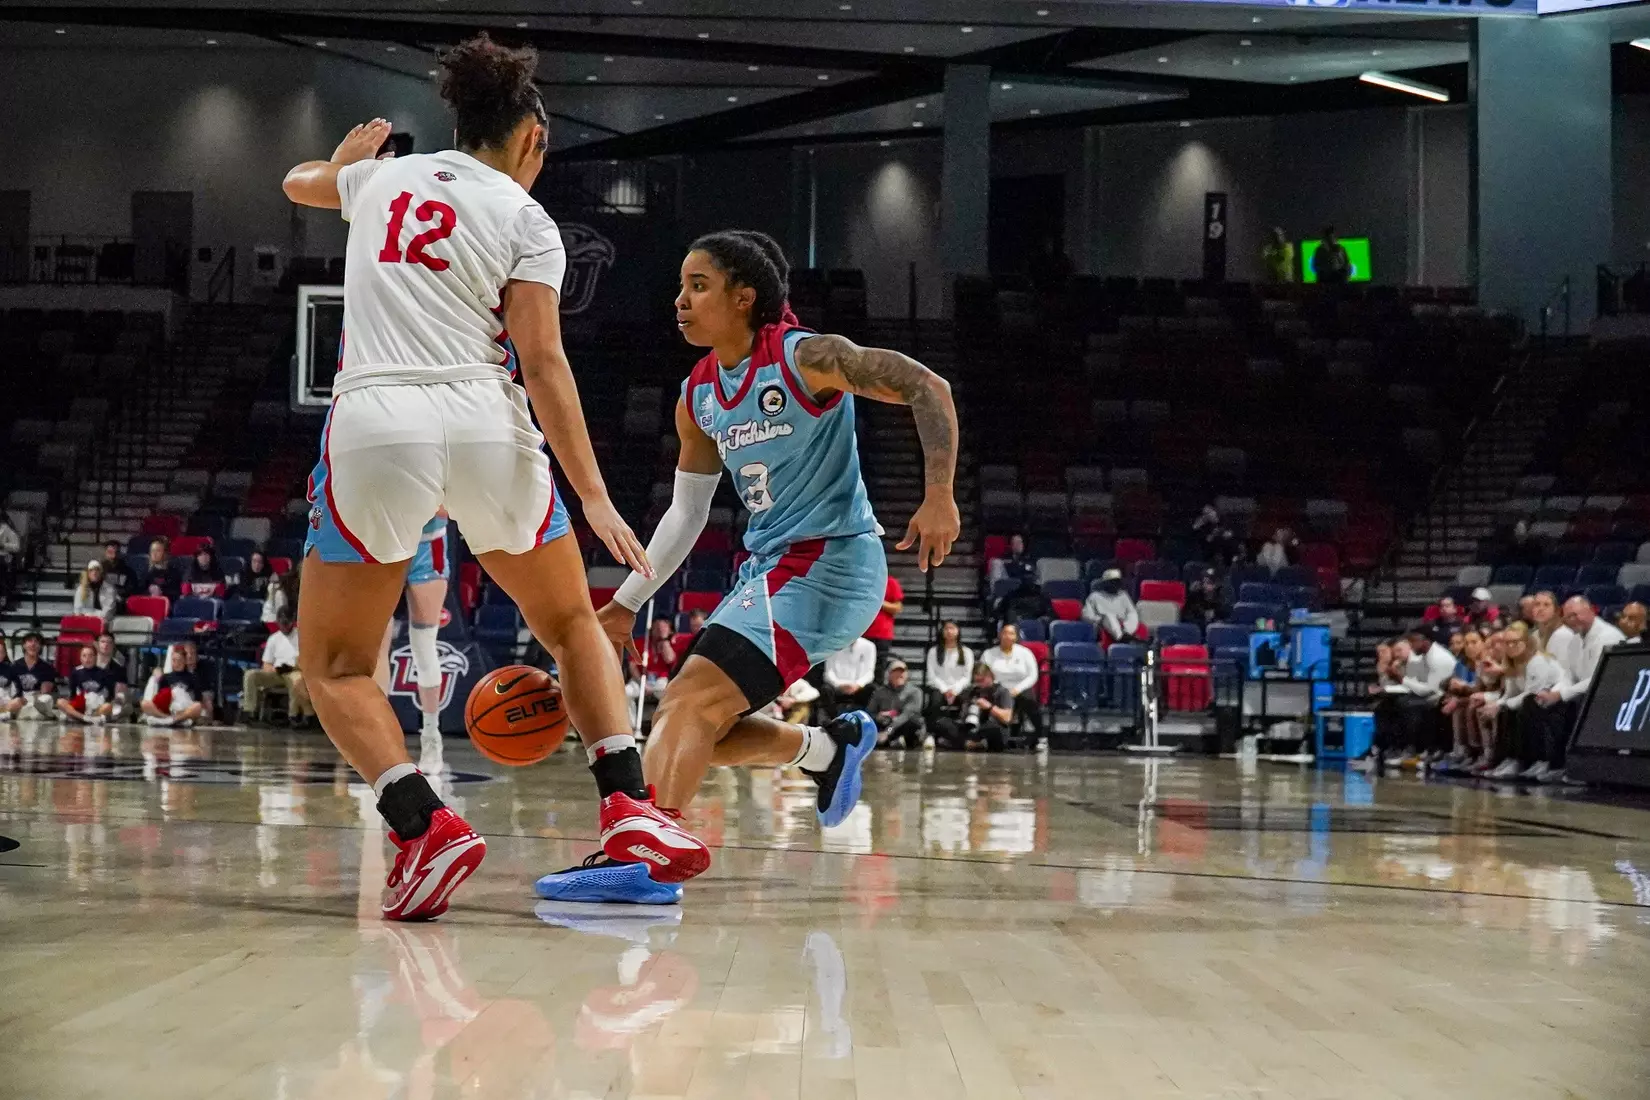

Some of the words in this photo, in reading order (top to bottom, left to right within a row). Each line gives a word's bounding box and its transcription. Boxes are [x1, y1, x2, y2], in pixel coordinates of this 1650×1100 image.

[378, 190, 457, 272] 12
[738, 462, 775, 513] 3
[505, 696, 559, 723] ELITE
